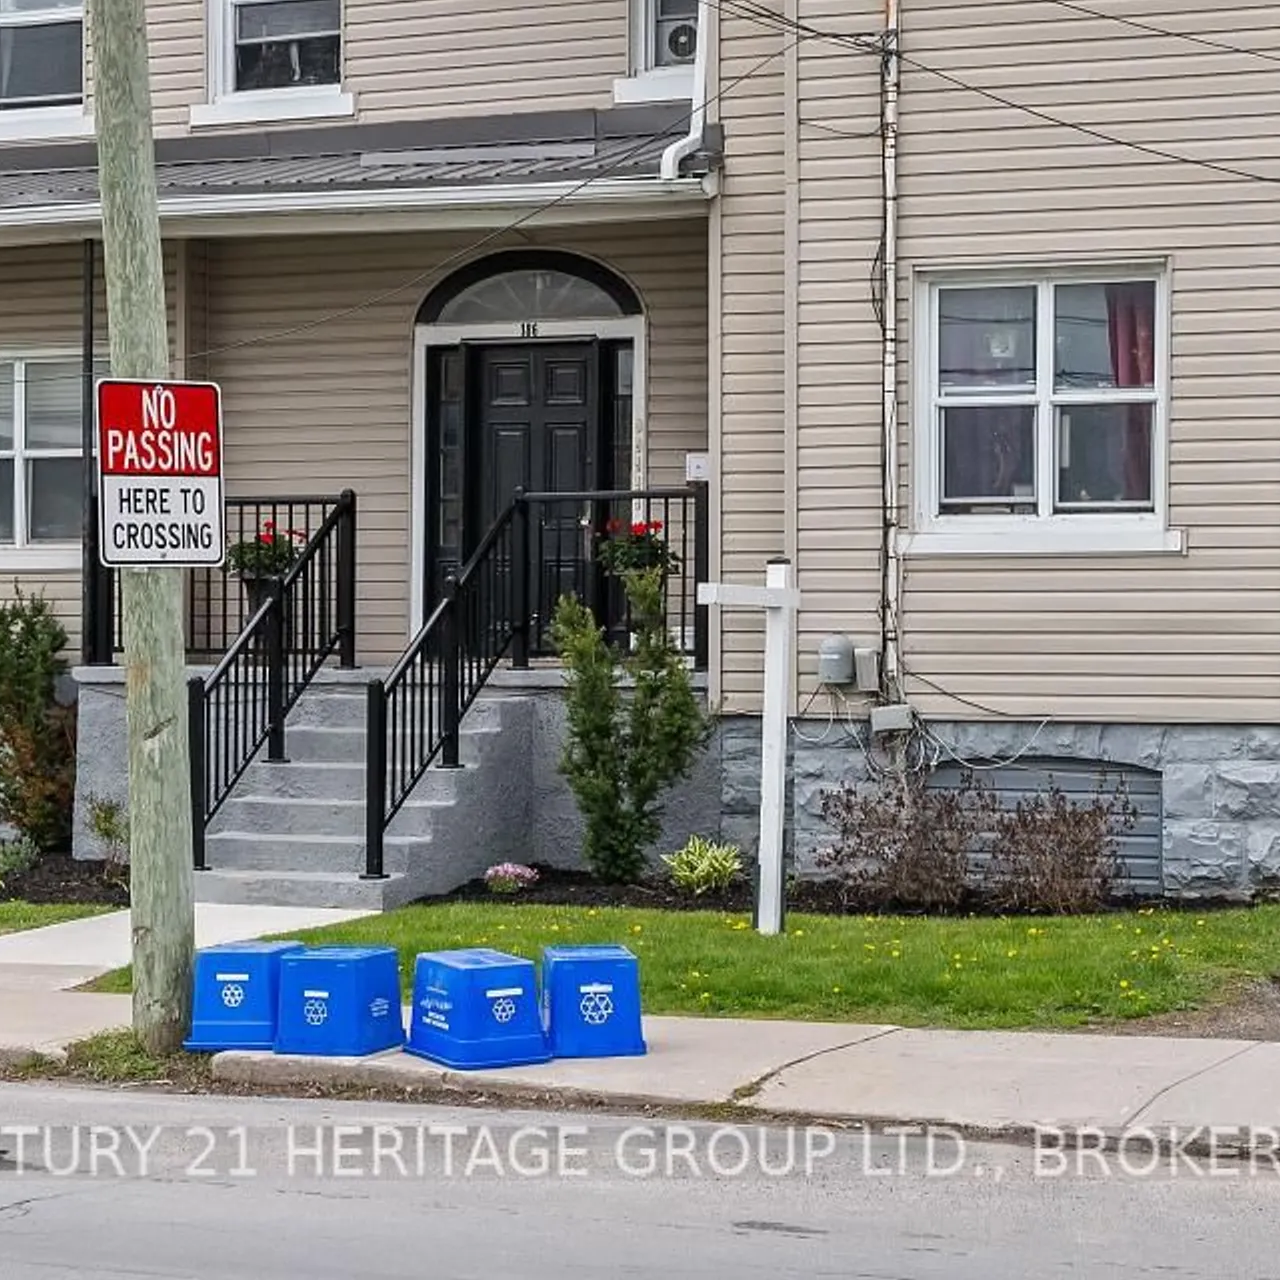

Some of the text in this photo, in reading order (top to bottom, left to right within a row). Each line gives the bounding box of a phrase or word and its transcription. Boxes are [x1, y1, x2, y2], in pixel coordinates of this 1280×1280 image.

[141, 389, 176, 429] NO
[107, 429, 213, 471] PASSING
[118, 488, 206, 515] HERE TO
[113, 523, 212, 549] CROSSING
